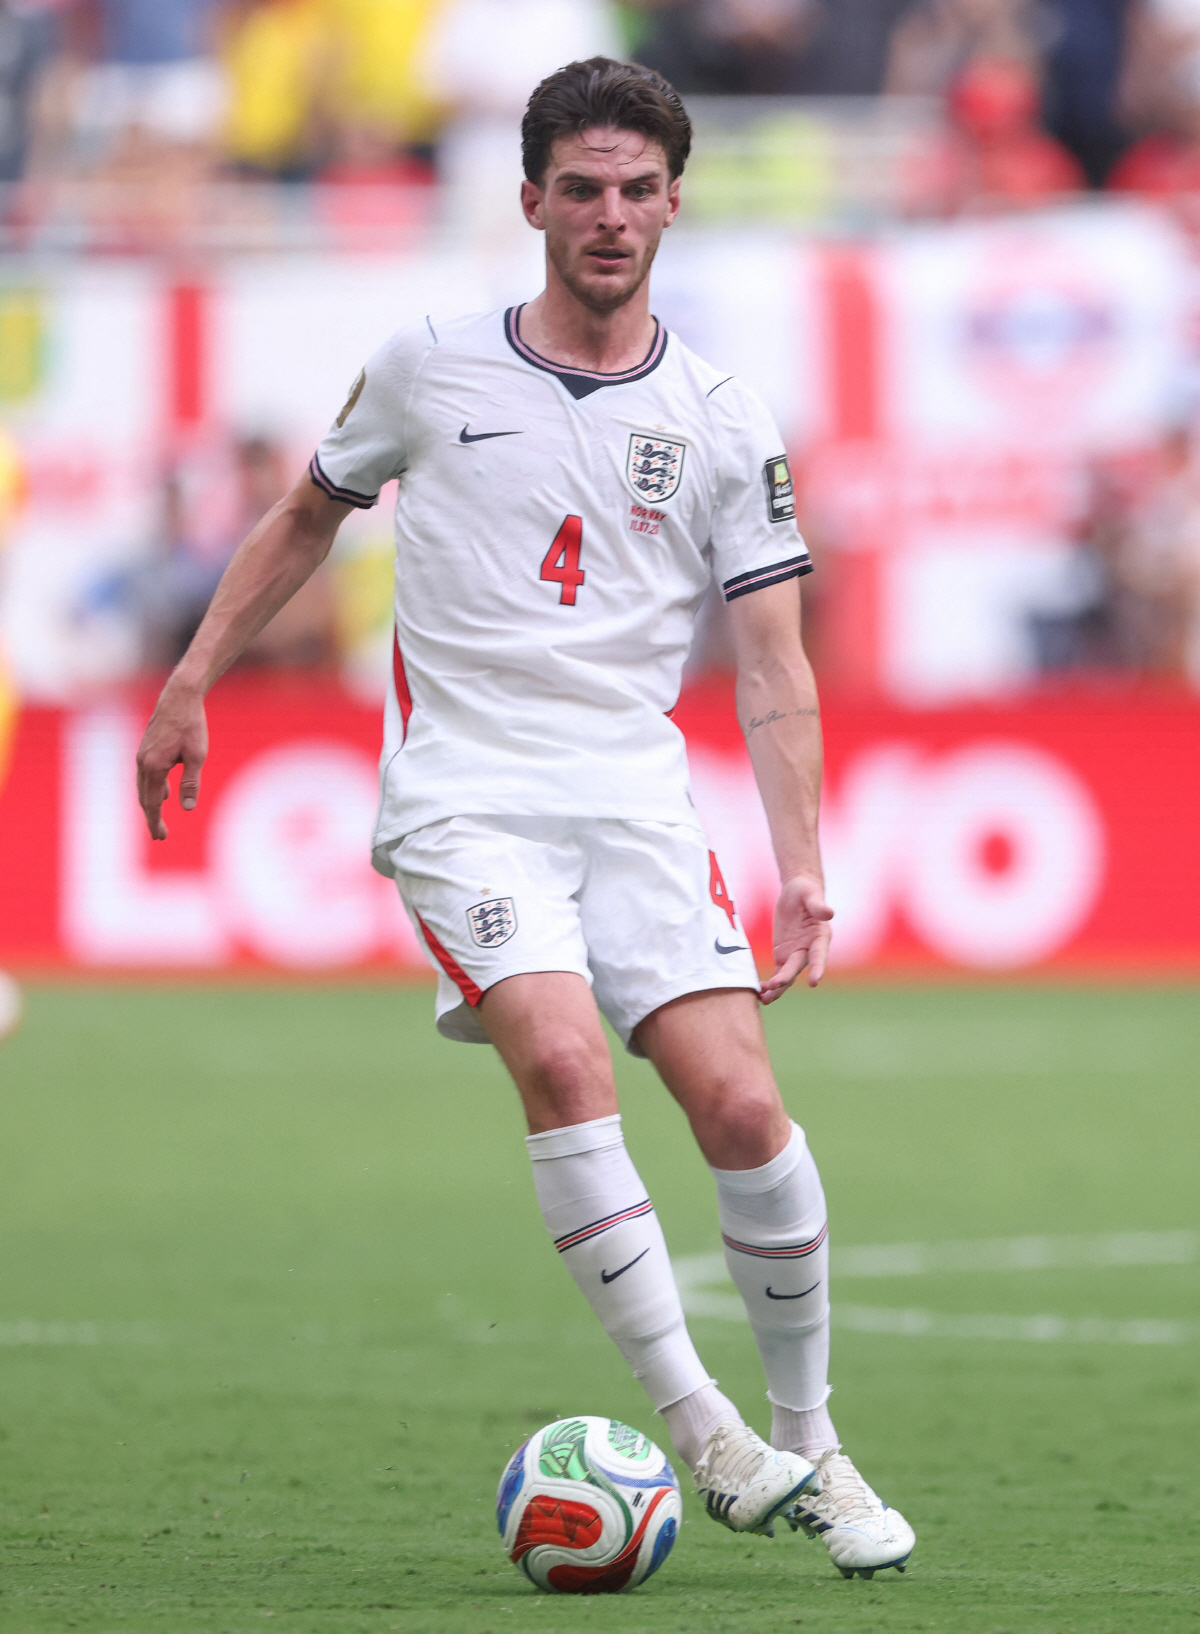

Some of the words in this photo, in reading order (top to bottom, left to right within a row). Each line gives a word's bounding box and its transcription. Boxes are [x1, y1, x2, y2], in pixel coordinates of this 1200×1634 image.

[630, 505, 667, 521] NORWAY
[540, 514, 585, 606] 4
[62, 702, 1107, 968] Levo
[708, 849, 737, 931] 4
